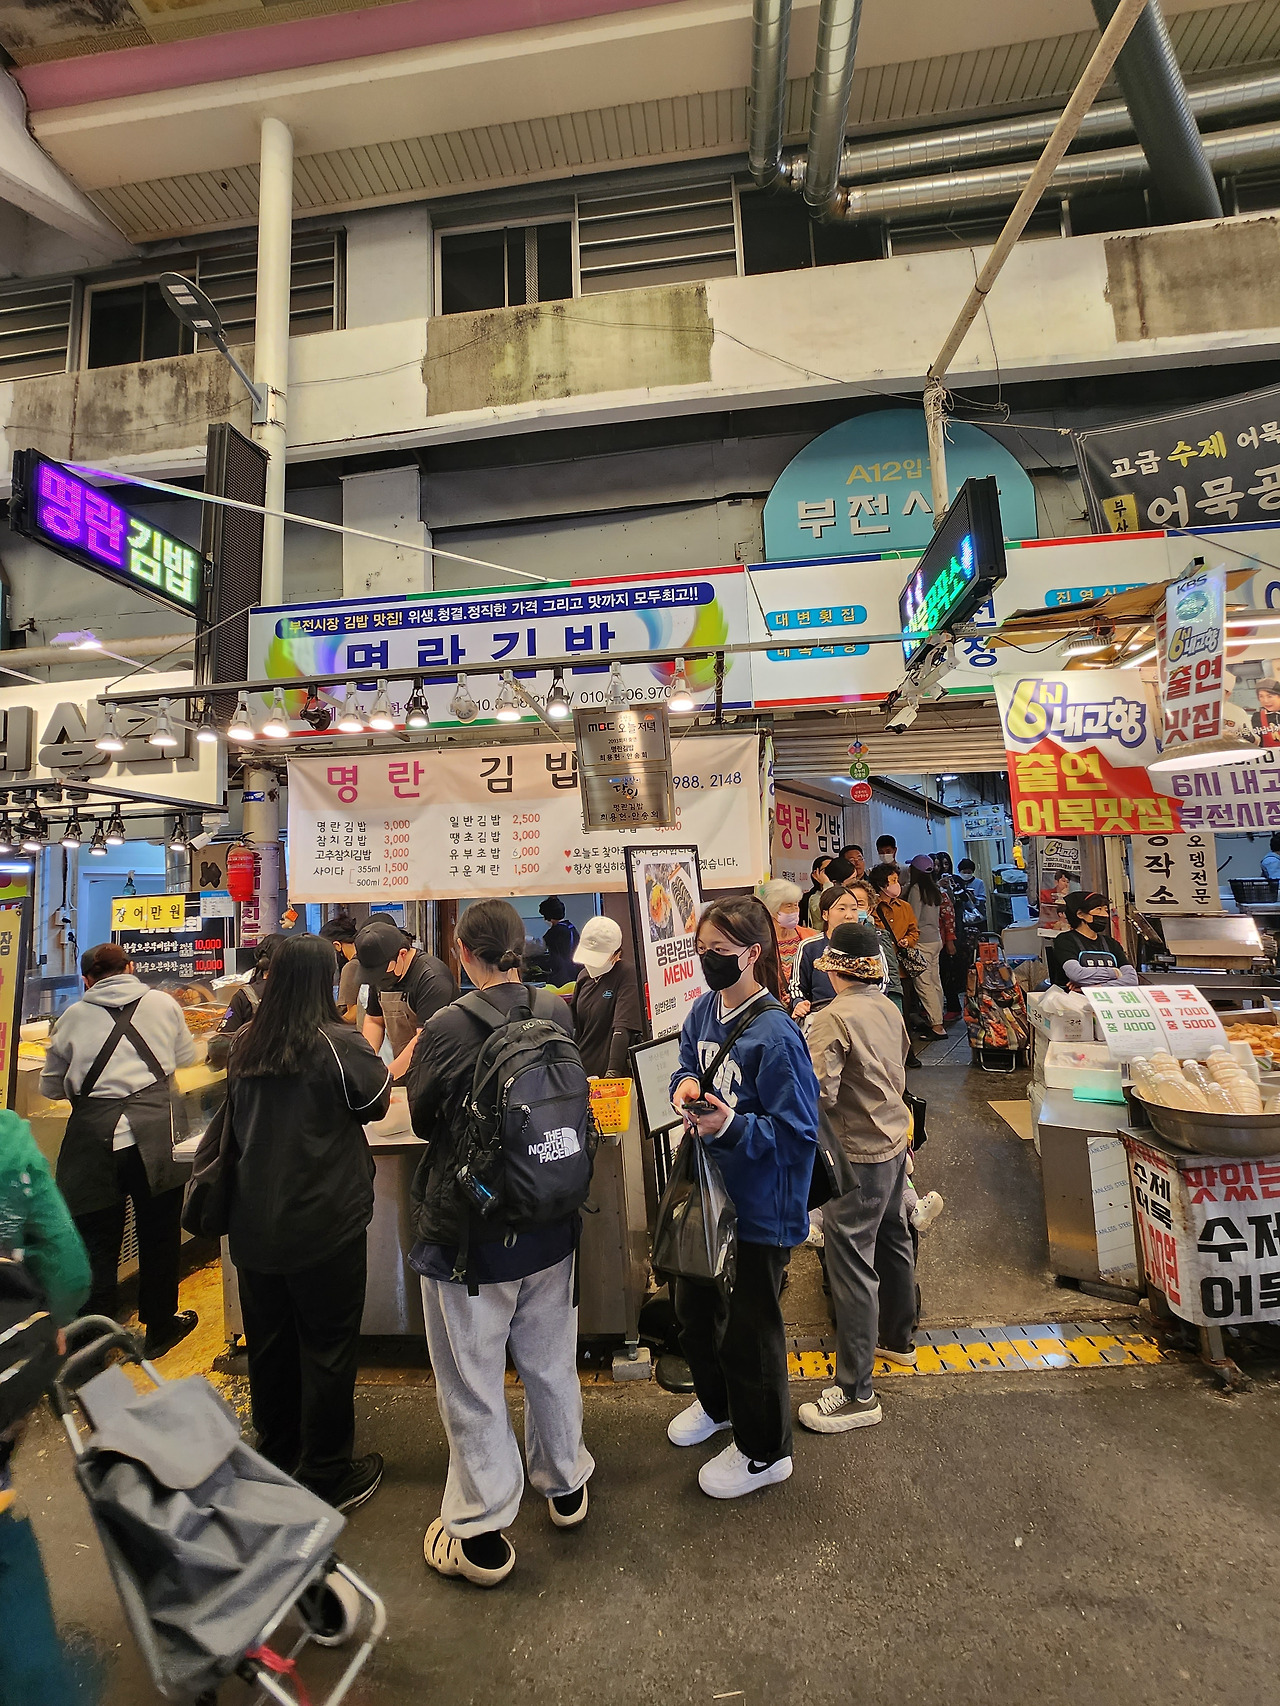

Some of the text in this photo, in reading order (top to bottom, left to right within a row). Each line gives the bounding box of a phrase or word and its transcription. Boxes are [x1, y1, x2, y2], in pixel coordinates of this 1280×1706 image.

[1110, 450, 1161, 478] 고급
[1167, 431, 1227, 468] 수제
[42, 466, 197, 605] 명란 김밥
[1176, 573, 1208, 595] KBS
[289, 617, 340, 633] 부전시장
[344, 614, 369, 629] 김밥
[373, 612, 403, 628] 맛집!
[512, 600, 538, 615] 가격
[542, 597, 584, 612] 그리고
[588, 593, 629, 609] 맛까지
[634, 587, 699, 605] 모두최고!!
[1167, 655, 1222, 701] 출연
[588, 722, 615, 732] MBC
[638, 722, 656, 732] 저녁
[1050, 700, 1143, 743] 내고향
[1165, 701, 1221, 744] 맛집
[710, 772, 742, 787] 2148
[1015, 752, 1107, 793] 출연
[1171, 770, 1221, 797] 6시
[450, 813, 540, 829] 일반김밥 2,500
[1017, 798, 1175, 833] 어묵맛집
[317, 819, 410, 833] 명란김밥 3,000
[776, 802, 842, 854] 명란 김밥
[316, 834, 410, 847] 참치김밥 3,000
[512, 829, 540, 842] 3,000
[315, 848, 410, 861] 고추참치김밥 3,000
[572, 847, 599, 860] 오늘도
[313, 863, 409, 876] 사이다 355ml 1,500
[514, 863, 540, 876] 1,500
[573, 863, 592, 875] 항상
[1186, 834, 1212, 904] 오뎅전문
[356, 876, 409, 888] 500ml 2,000
[194, 938, 222, 950] 10,000
[195, 959, 223, 971] 10,000
[664, 960, 694, 987] MENU
[1092, 990, 1141, 1005] 식혜
[1101, 1006, 1210, 1019] 대 6000 대 7000
[1106, 1018, 1217, 1033] 중 4000 중 5000
[543, 1129, 563, 1144] THE
[528, 1140, 564, 1156] NORTH
[539, 1149, 568, 1165] FACE
[1133, 1161, 1171, 1203] 수제
[1135, 1185, 1172, 1231] 어묵
